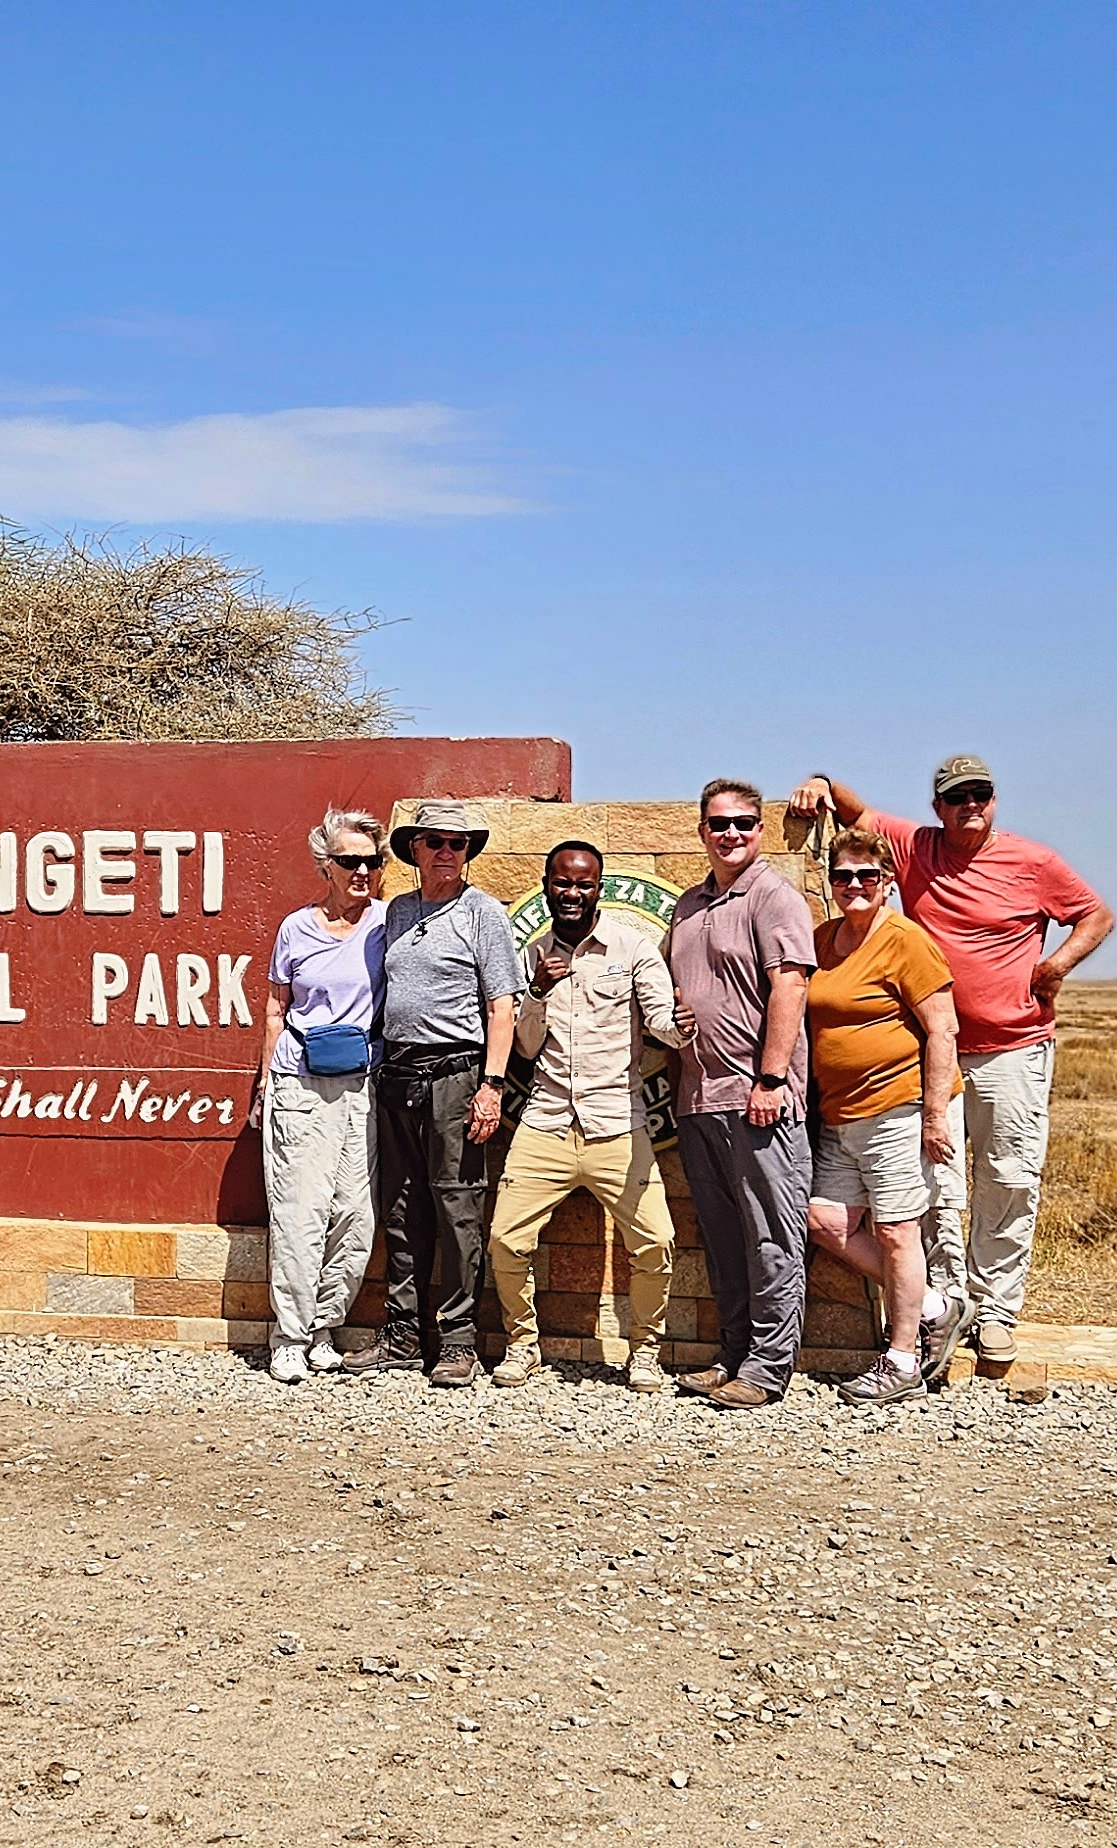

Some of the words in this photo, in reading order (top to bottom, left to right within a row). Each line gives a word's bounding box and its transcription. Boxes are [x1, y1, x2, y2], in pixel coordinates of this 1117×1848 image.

[615, 880, 645, 903] ZA
[91, 952, 255, 1027] PARK
[100, 1080, 234, 1126] Never
